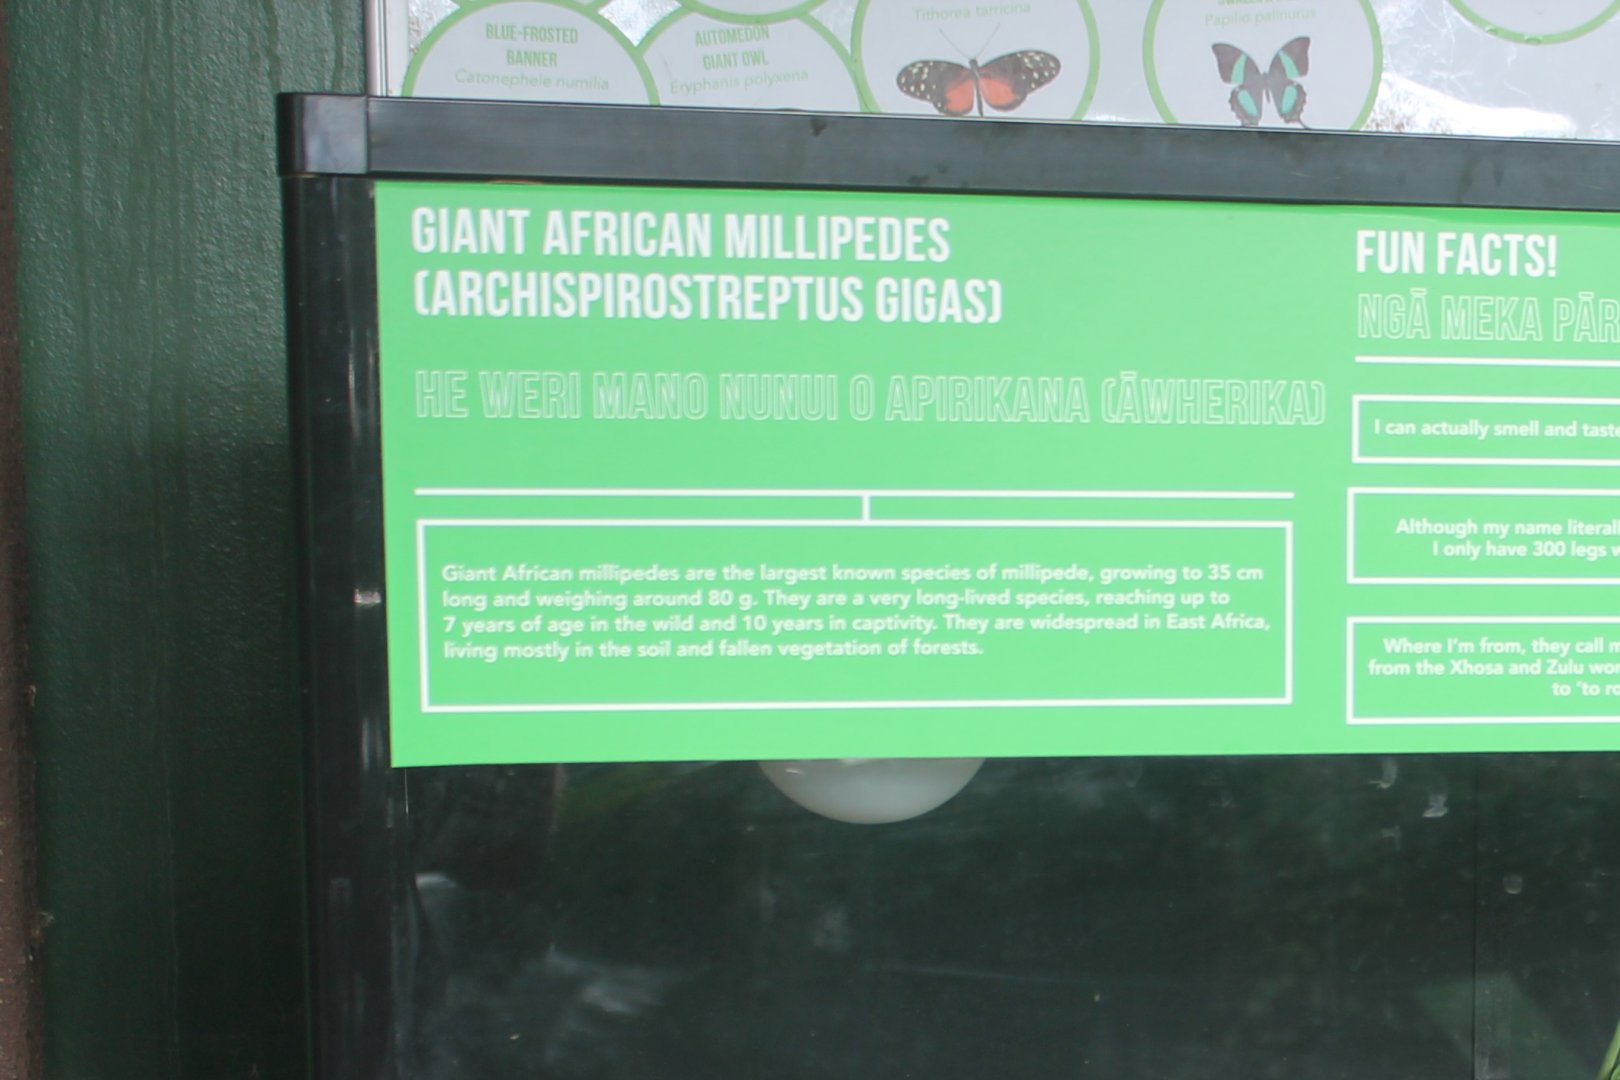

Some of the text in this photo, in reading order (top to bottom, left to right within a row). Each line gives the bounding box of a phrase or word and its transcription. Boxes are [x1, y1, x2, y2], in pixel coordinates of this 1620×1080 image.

[486, 23, 579, 44] BLUE-FROSTED
[695, 26, 769, 47] AUTOMEDON
[506, 49, 558, 68] BANNER
[703, 49, 768, 70] GIANT OWL
[455, 69, 609, 91] Catonephele numilia
[670, 70, 808, 95] Eryphanis polyxena
[411, 206, 950, 262] GIANT AFRICAN MILLIPEDES
[1356, 229, 1557, 277] FUN FACTS!
[414, 269, 1002, 324] (ARCHISPIROSTREPTUS GIGAS)
[1358, 287, 1431, 339] NGĀ
[1440, 294, 1543, 342] MEKA
[416, 369, 1326, 426] HE WERI MANO NUNUI O APIRIKANA (ĀWHERIKA)
[1374, 418, 1380, 433] I
[1385, 422, 1416, 434] can
[1421, 419, 1489, 440] actually
[1493, 419, 1539, 436] smell
[1544, 420, 1578, 436] and
[1396, 518, 1478, 539] Although
[1483, 522, 1510, 538] my
[1514, 522, 1562, 534] name
[1432, 541, 1438, 555] I
[1443, 540, 1481, 560] only
[1486, 540, 1527, 556] have
[1533, 540, 1566, 556] 300
[1571, 540, 1606, 561] legs
[441, 562, 1263, 585] Giant African millipedes are the largest known species of millipede, growing to 35 cm
[442, 588, 1230, 611] long and weighing around 80 g. They are a very long-lived species, reaching up to
